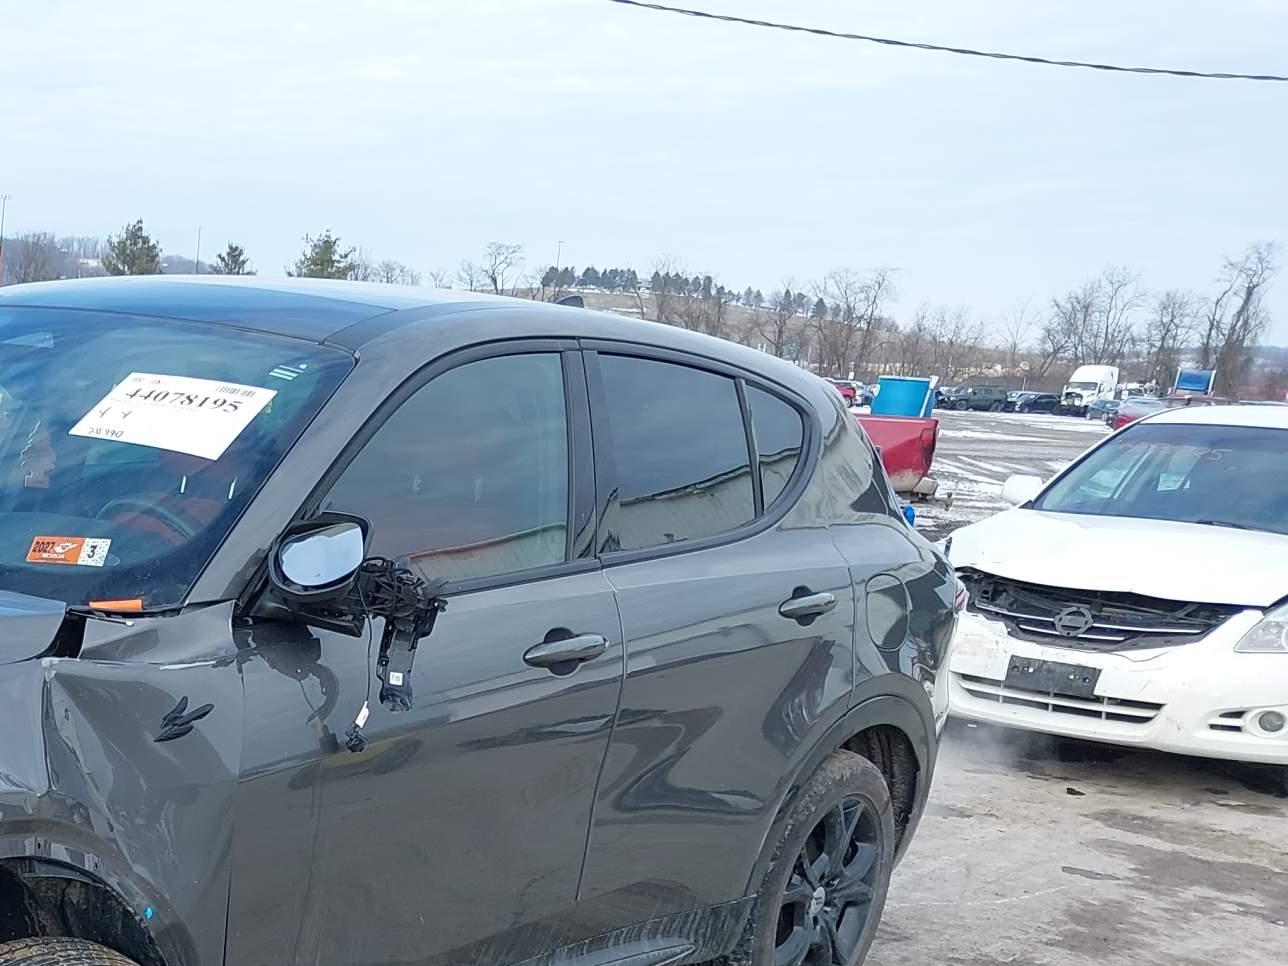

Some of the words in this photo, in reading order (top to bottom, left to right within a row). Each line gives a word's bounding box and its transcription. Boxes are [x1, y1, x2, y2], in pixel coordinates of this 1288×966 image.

[125, 388, 244, 413] 44078195
[32, 541, 56, 554] 2027
[87, 544, 98, 559] 3
